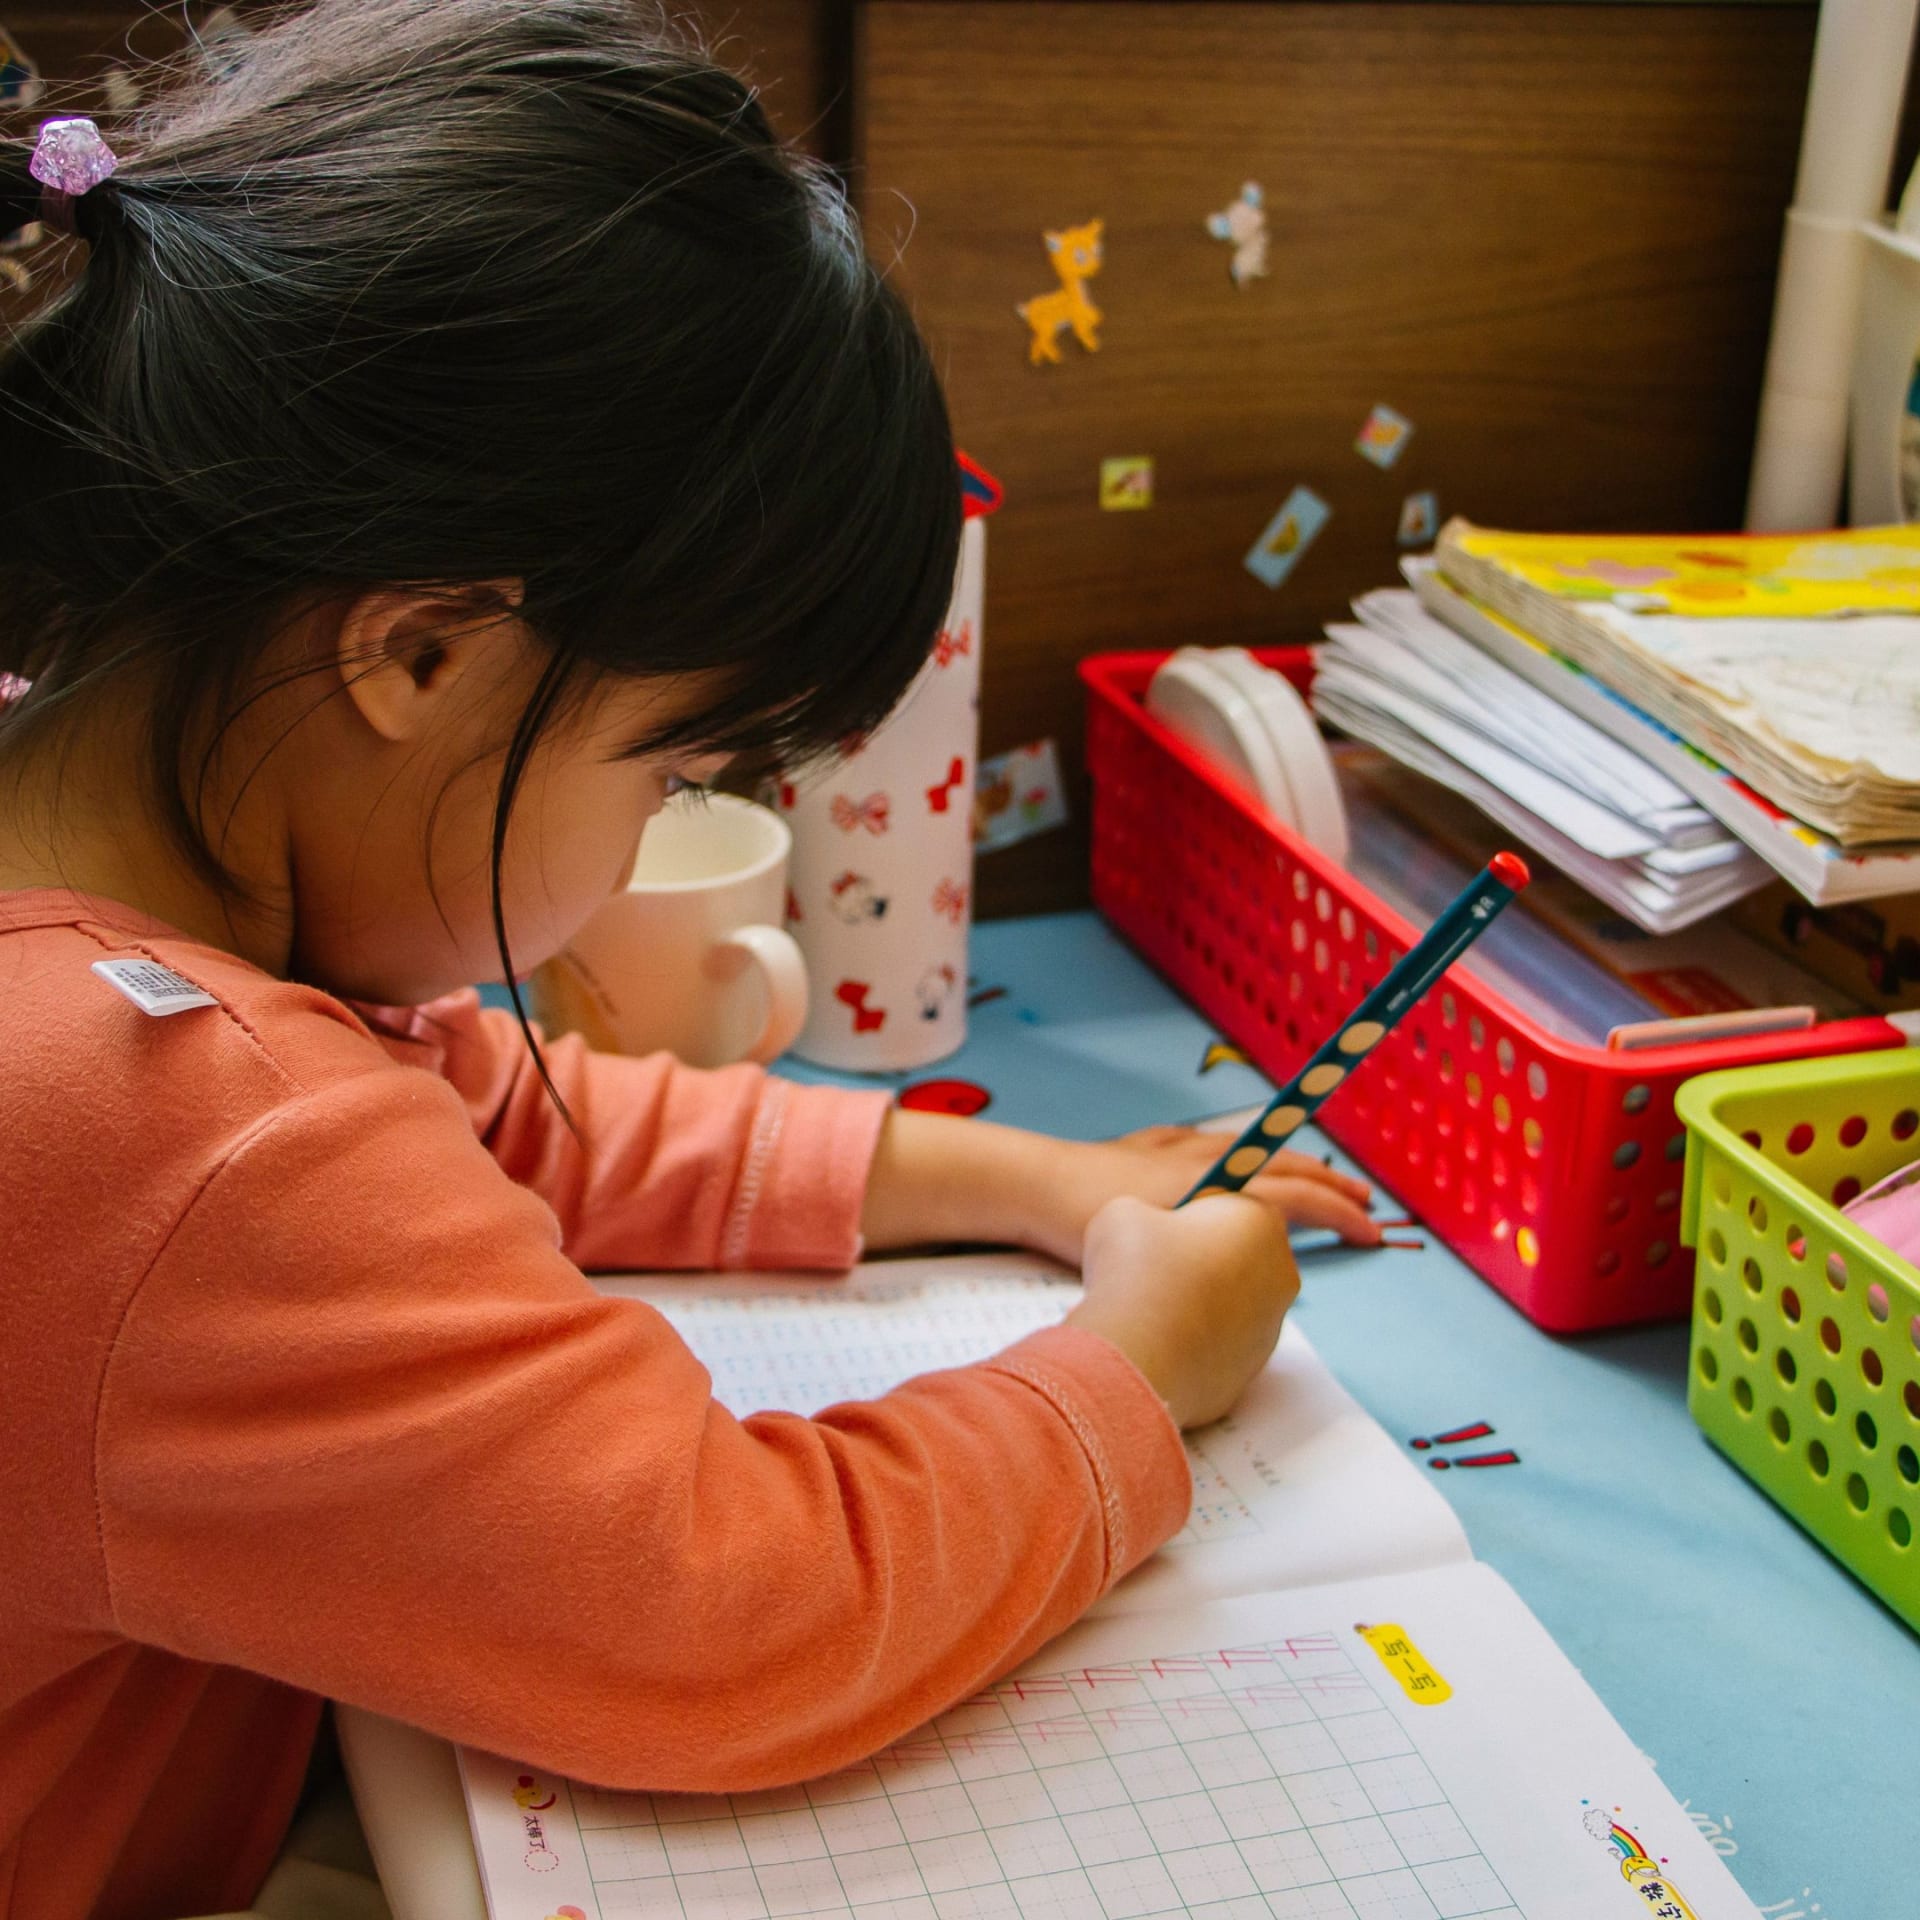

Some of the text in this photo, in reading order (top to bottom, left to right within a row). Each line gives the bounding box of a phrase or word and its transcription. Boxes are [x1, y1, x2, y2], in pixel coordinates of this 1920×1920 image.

[1382, 1639, 1437, 1690] 写一写
[523, 1815, 546, 1849] 太棒了
[1639, 1882, 1682, 1919] 数字
